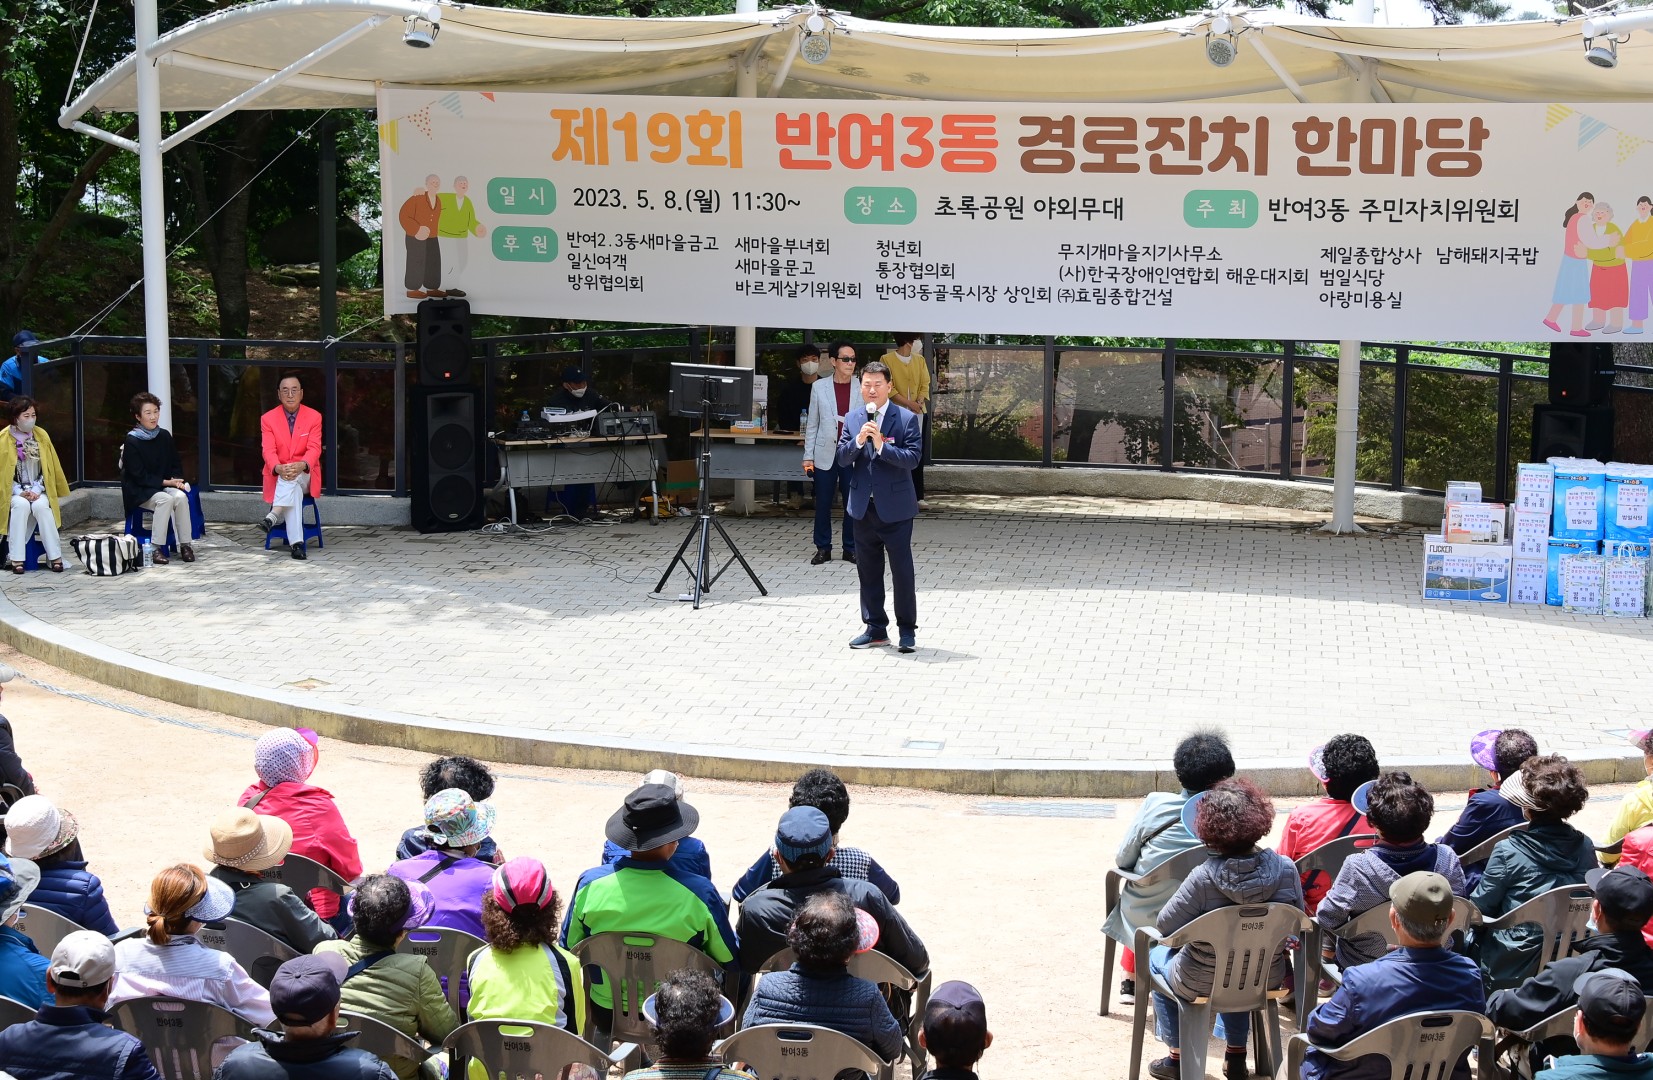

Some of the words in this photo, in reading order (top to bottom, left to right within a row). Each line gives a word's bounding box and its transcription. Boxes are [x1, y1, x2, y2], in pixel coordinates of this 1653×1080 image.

[550, 108, 742, 168] 제19회
[776, 112, 998, 171] 반여3동
[1017, 114, 1270, 177] 경로잔치
[1291, 115, 1490, 178] 한마당
[574, 188, 626, 209] 2023.
[638, 190, 654, 210] 5.
[733, 192, 800, 211] 11:30~
[935, 196, 1023, 220] 초록공원
[1034, 197, 1123, 221] 야외무대
[1269, 198, 1349, 222] 반여3동
[1359, 198, 1518, 223] 주민자치위원회
[735, 237, 829, 255] 새마을부녀회
[876, 240, 921, 257] 청년회
[1058, 244, 1222, 262] 무지개마을지기사무소
[568, 253, 627, 271] 일신여객
[1321, 247, 1422, 265] 제일종합상사
[1437, 247, 1539, 265] 남해돼지국밥
[735, 258, 815, 276] 새마을문고
[876, 262, 954, 279] 통장협의회
[1060, 265, 1218, 284] (사)한국장애인연합회
[1226, 268, 1308, 285] 해운대지회
[568, 274, 643, 292] 방위협의회
[1320, 269, 1384, 287] 범일식당
[736, 280, 861, 299] 바르게살기위원회
[876, 283, 997, 303] 반여3동골목시장
[1004, 286, 1051, 303] 상인회
[1320, 291, 1401, 309] 아랑미용실
[1569, 903, 1590, 912] 반여3동
[1241, 922, 1265, 931] 반여3동
[202, 934, 226, 945] 반여3동
[412, 947, 438, 955] 반여3동
[626, 950, 652, 961] 반여3동
[156, 1017, 183, 1028] 반여3동
[1420, 1031, 1446, 1043] 반여3동
[503, 1041, 531, 1052] 반여3동
[780, 1046, 809, 1058] 반여3동
